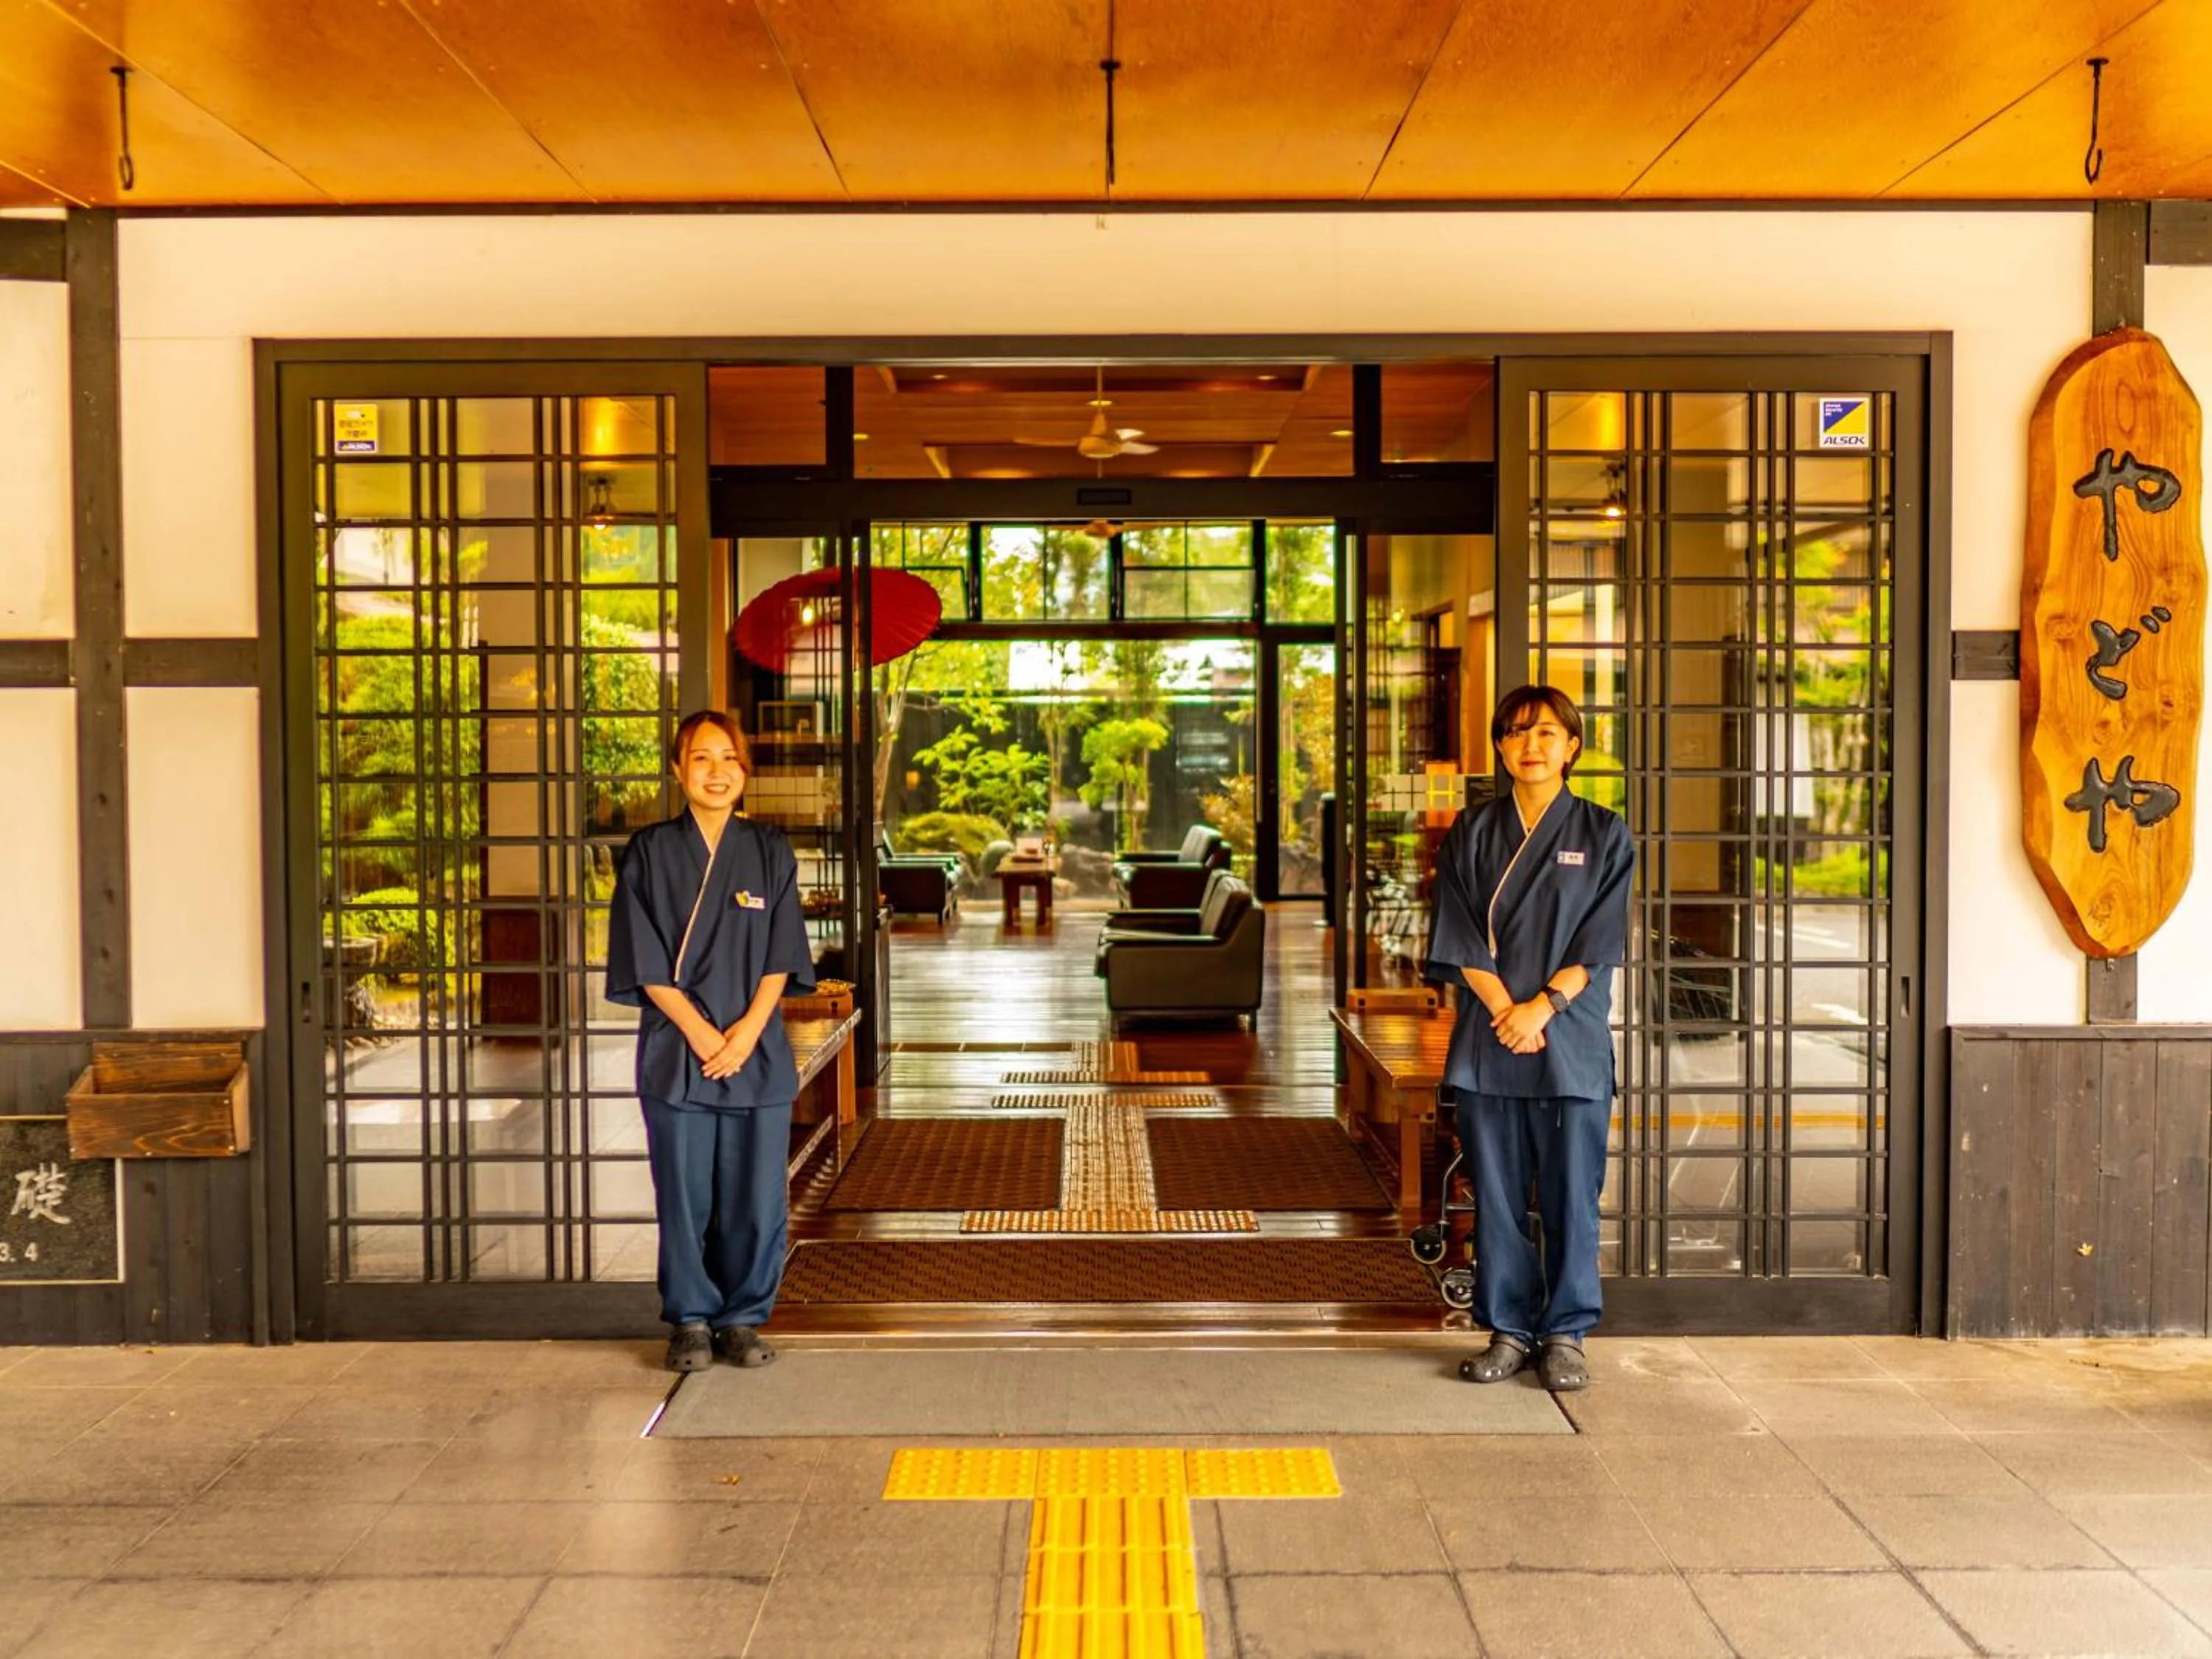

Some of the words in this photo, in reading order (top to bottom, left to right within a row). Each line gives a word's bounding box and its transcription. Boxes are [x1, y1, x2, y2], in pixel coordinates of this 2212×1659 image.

[1823, 436, 1865, 445] ALSOK
[2065, 448, 2181, 852] やどや
[10, 1162, 71, 1224] 礎
